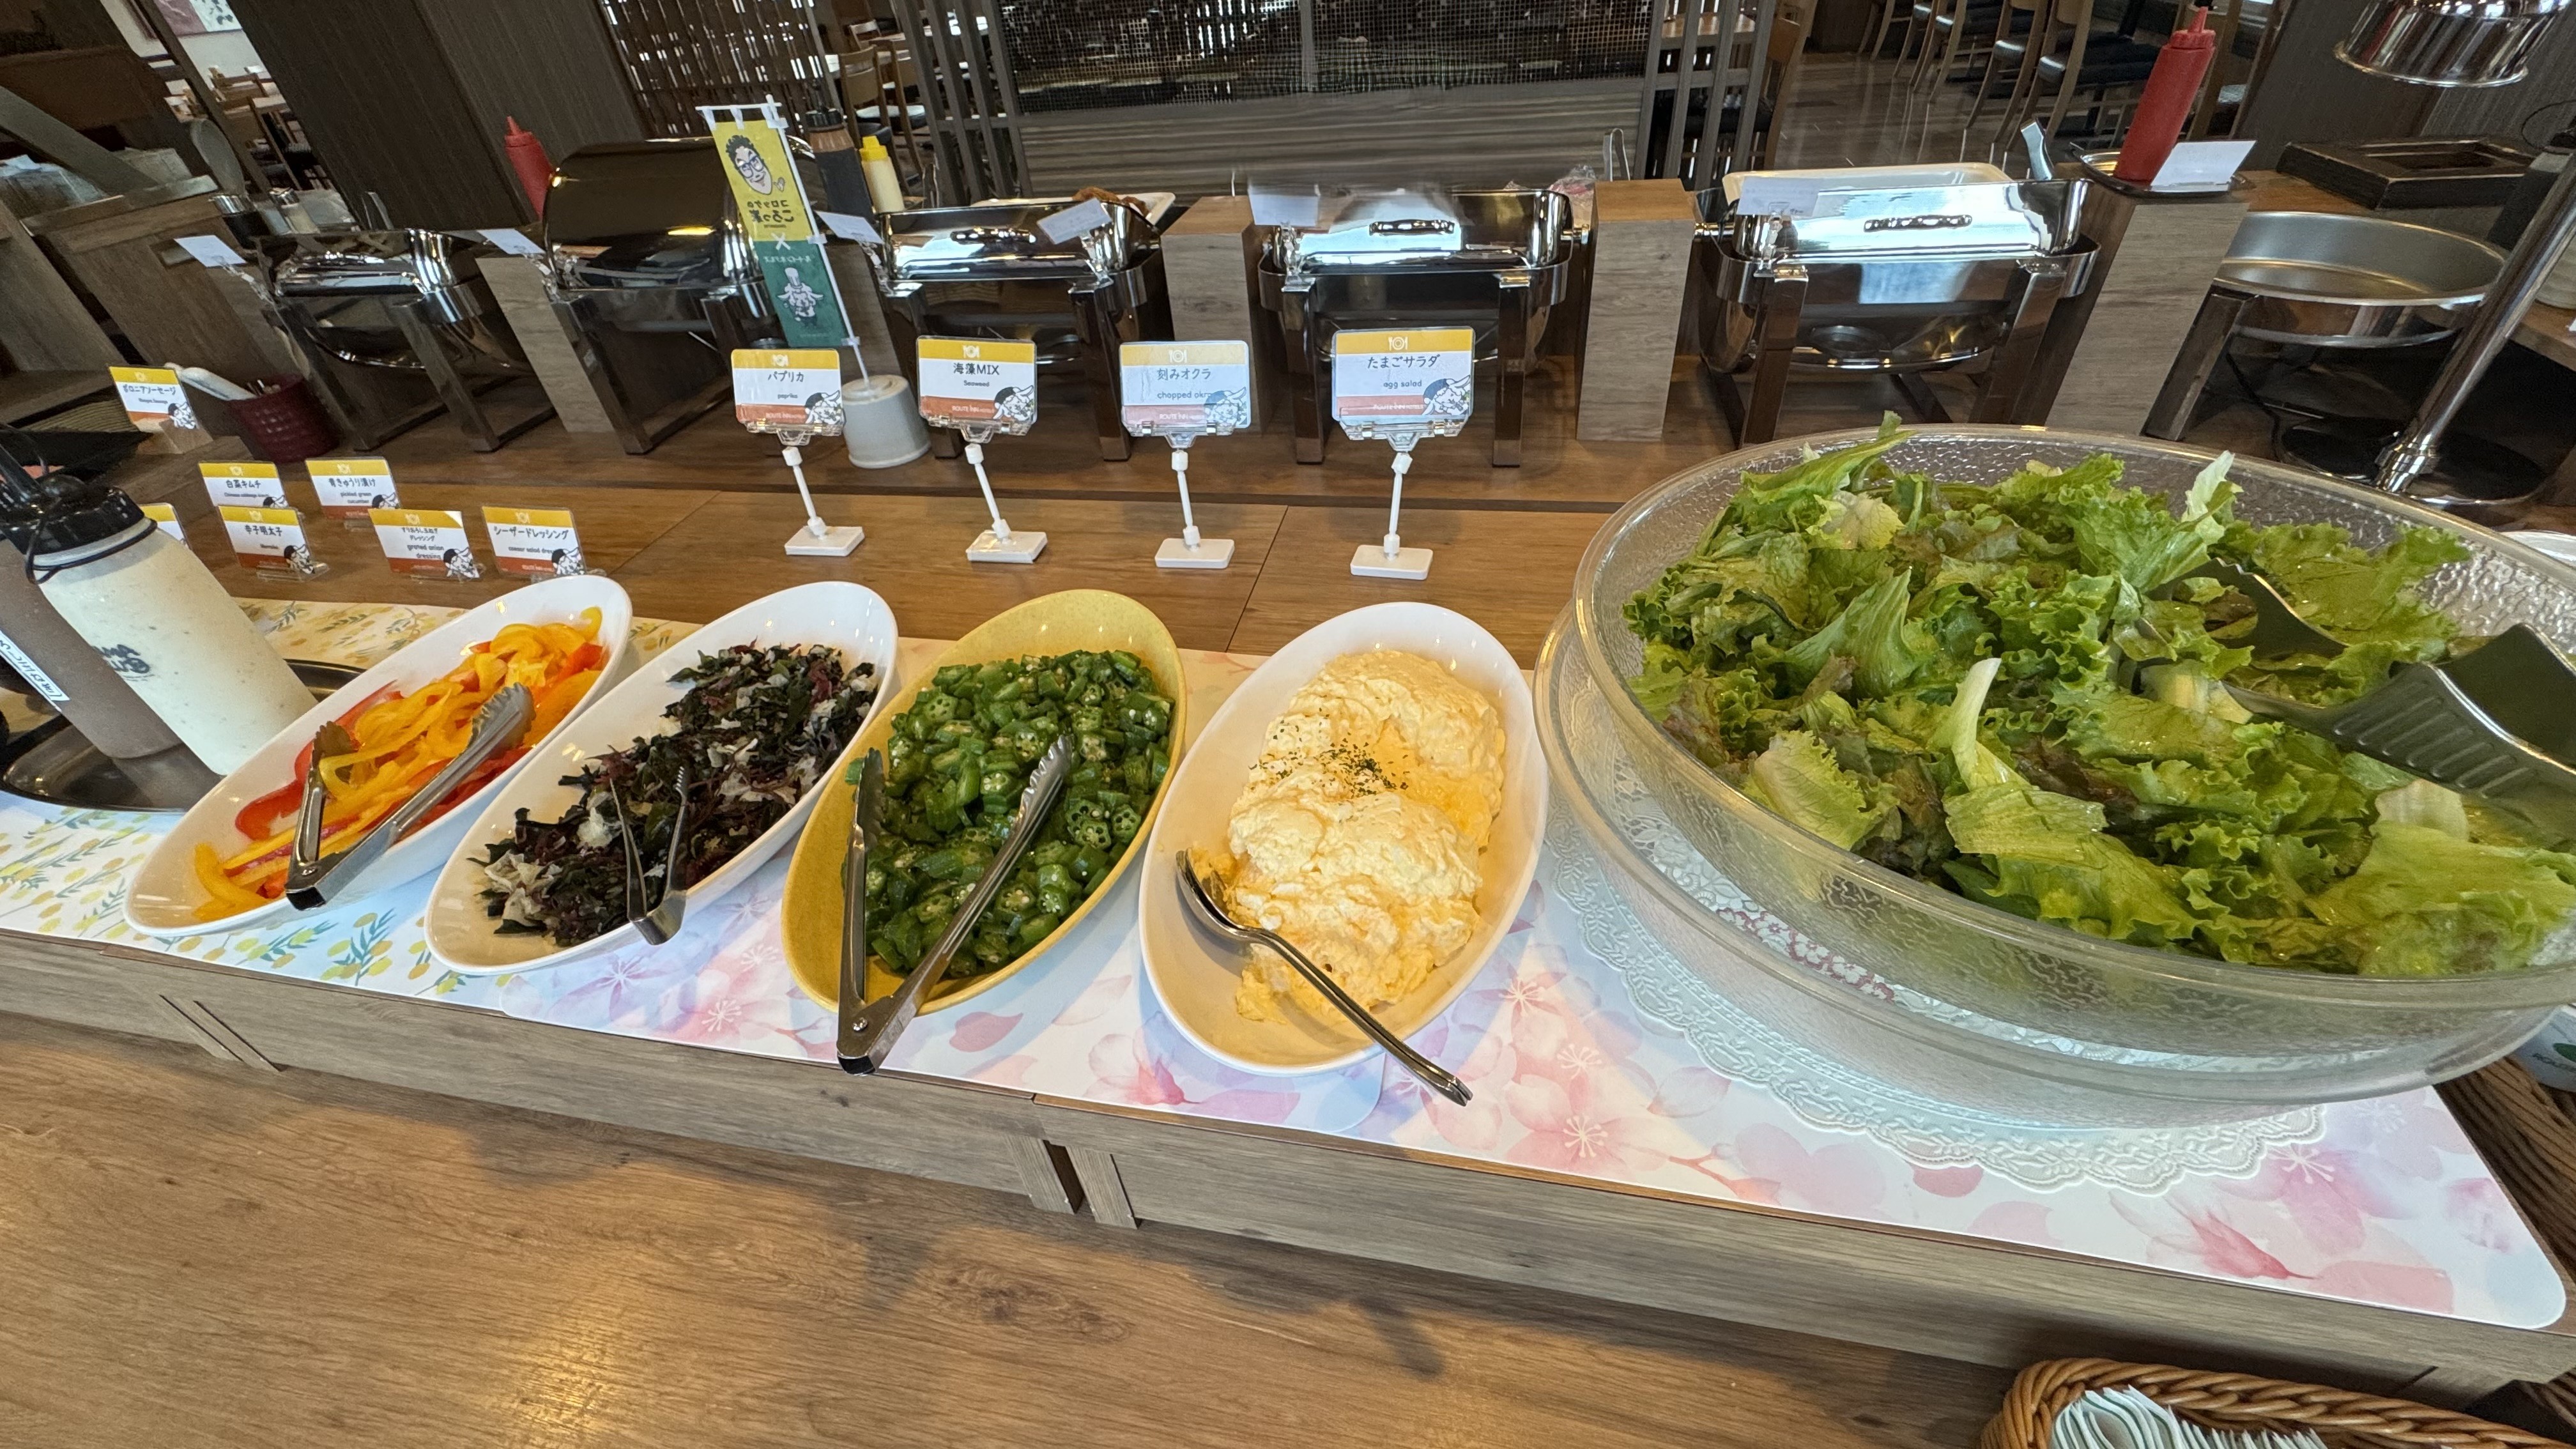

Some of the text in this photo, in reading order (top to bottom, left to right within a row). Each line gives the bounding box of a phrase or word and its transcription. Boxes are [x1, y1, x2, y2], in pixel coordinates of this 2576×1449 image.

[1367, 354, 1440, 369] たまごサラダ
[953, 362, 1000, 376] 海藻MIX
[1156, 368, 1211, 381] 刻みオクラ
[767, 371, 804, 383] パプリカ
[1383, 381, 1398, 389] egg
[1156, 391, 1192, 400] chopped
[226, 479, 261, 489] 白菜キムチ
[328, 477, 376, 487] 青きゅうり漬け
[493, 526, 569, 540] シーザードレッシング
